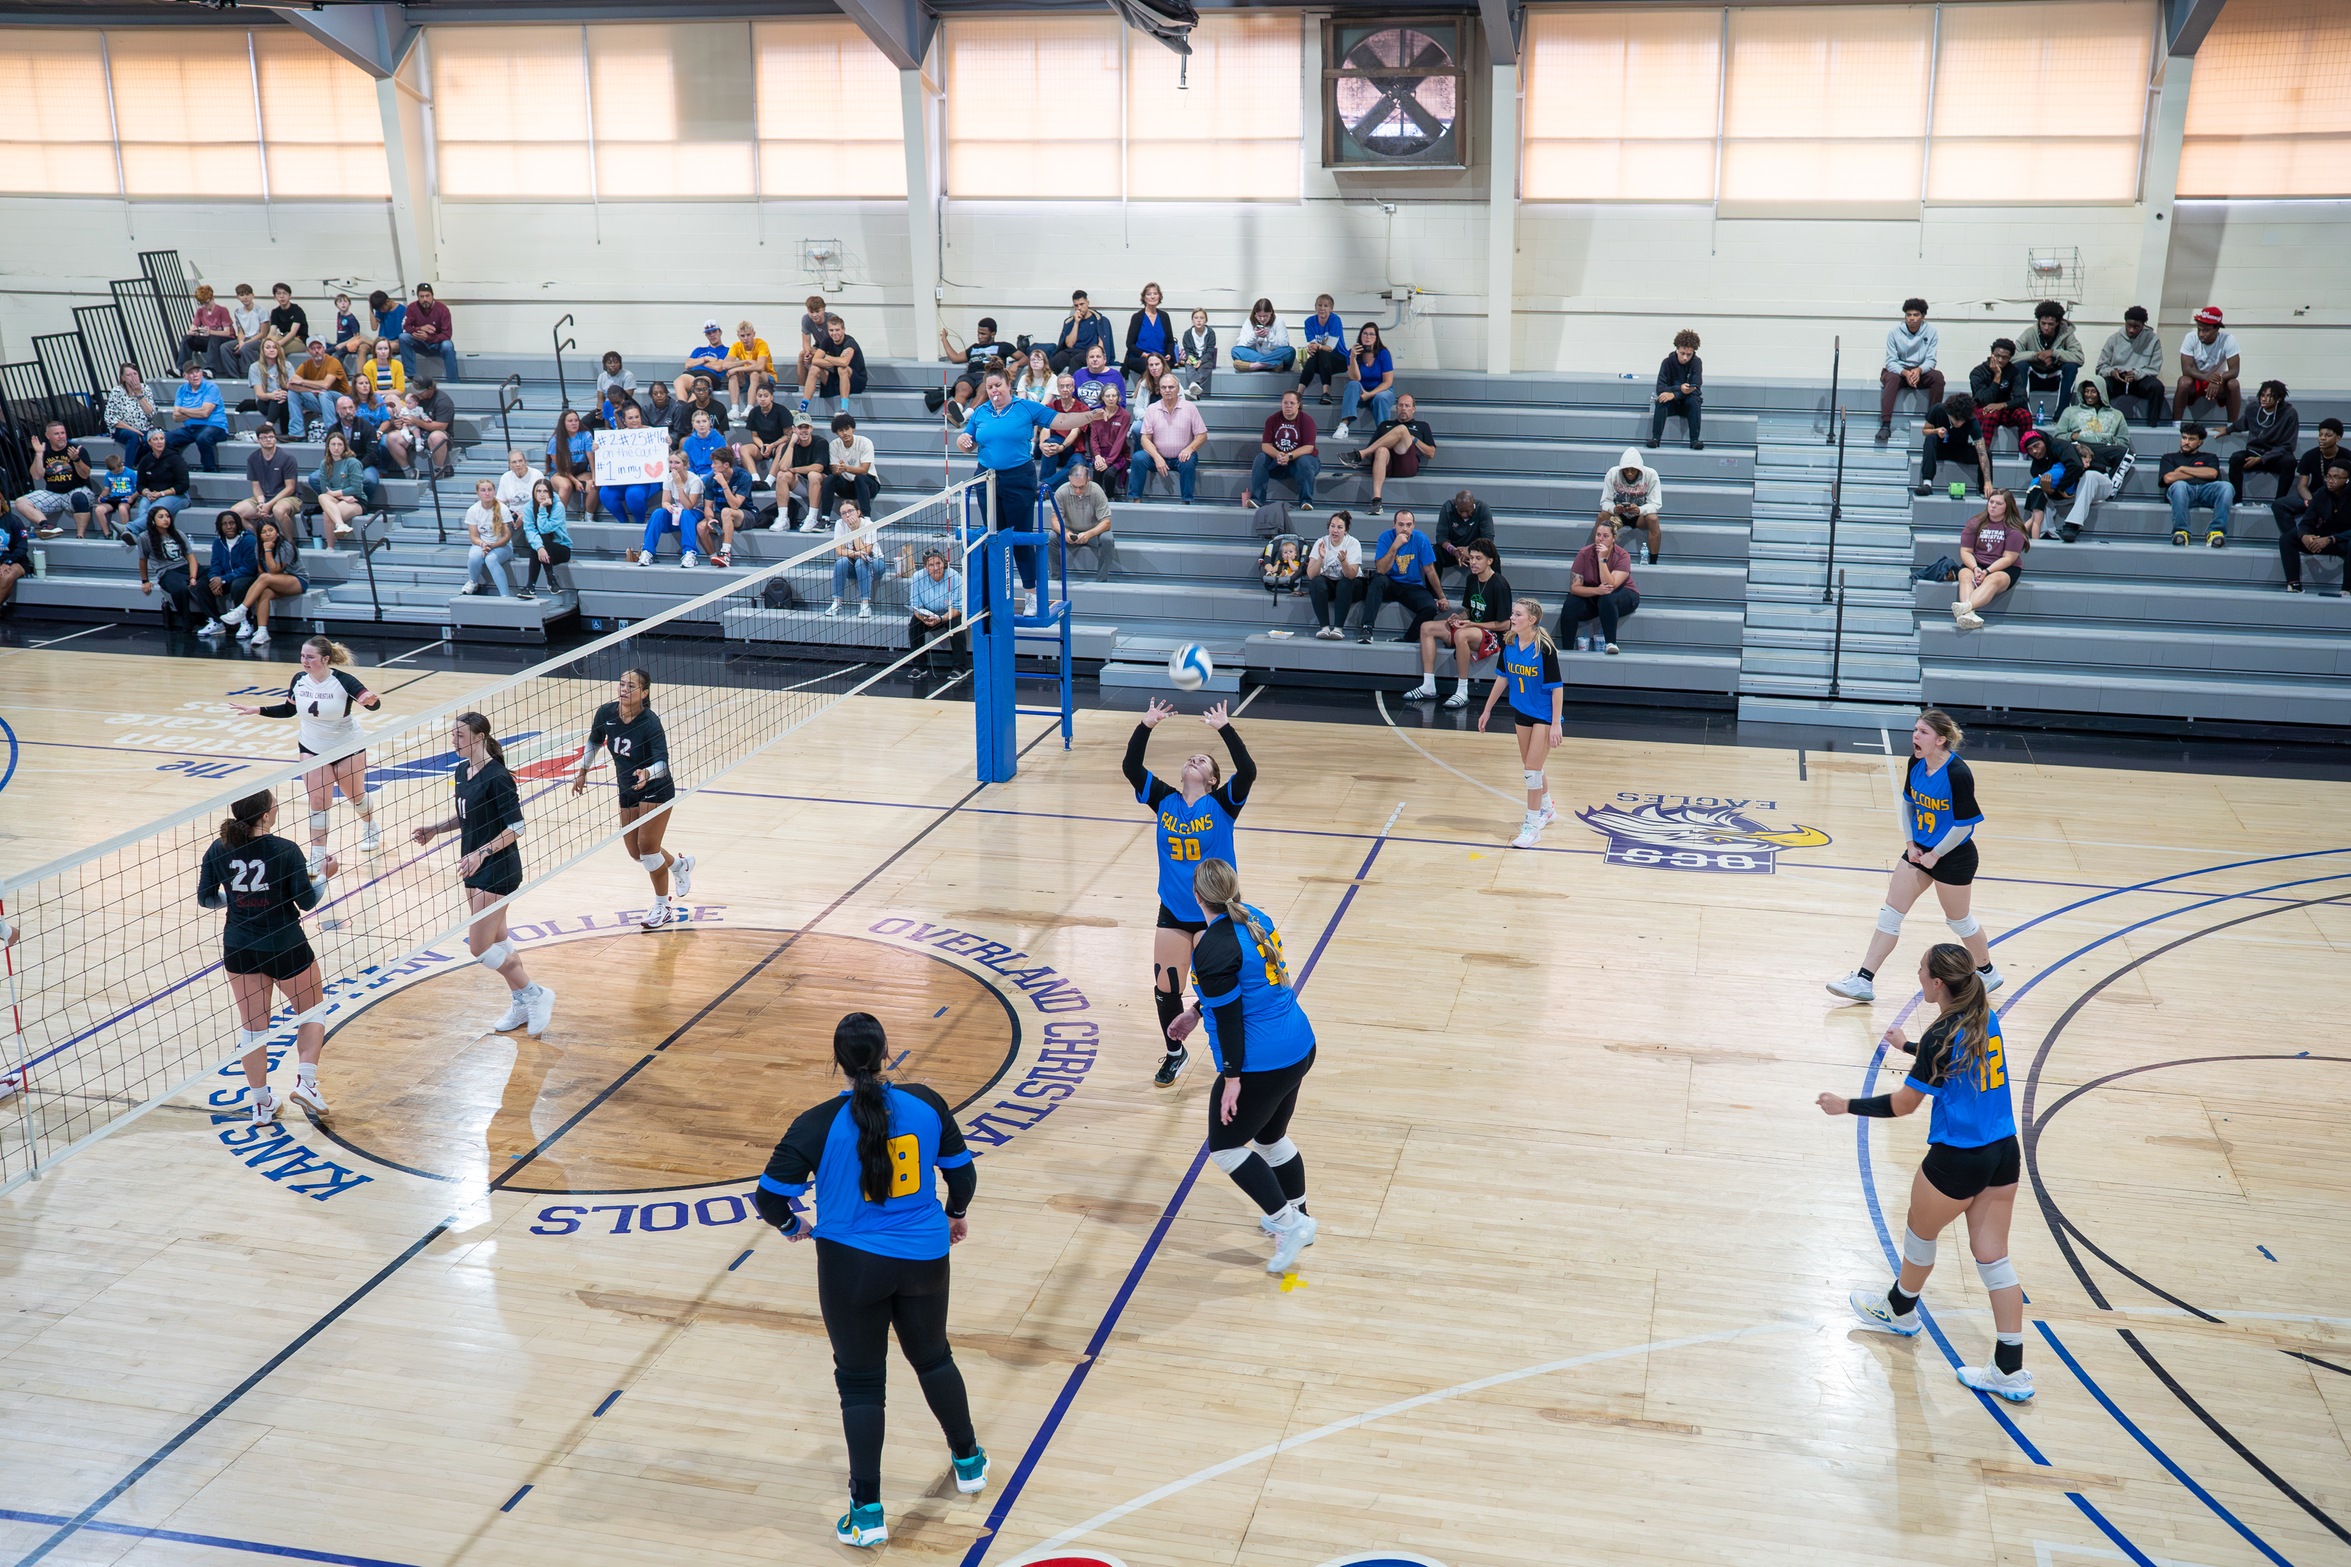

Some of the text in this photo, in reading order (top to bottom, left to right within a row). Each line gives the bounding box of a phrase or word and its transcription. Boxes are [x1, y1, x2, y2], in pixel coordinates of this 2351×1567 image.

[627, 465, 642, 479] my
[1518, 677, 1525, 694] 1
[308, 700, 320, 718] 4
[613, 736, 632, 757] 12
[156, 760, 251, 779] The
[1616, 792, 1778, 811] EAGLES
[1167, 836, 1202, 862] 30
[228, 858, 270, 893] 22
[868, 917, 1091, 1014] OVERLAND
[964, 1021, 1100, 1158] CHRISTIA
